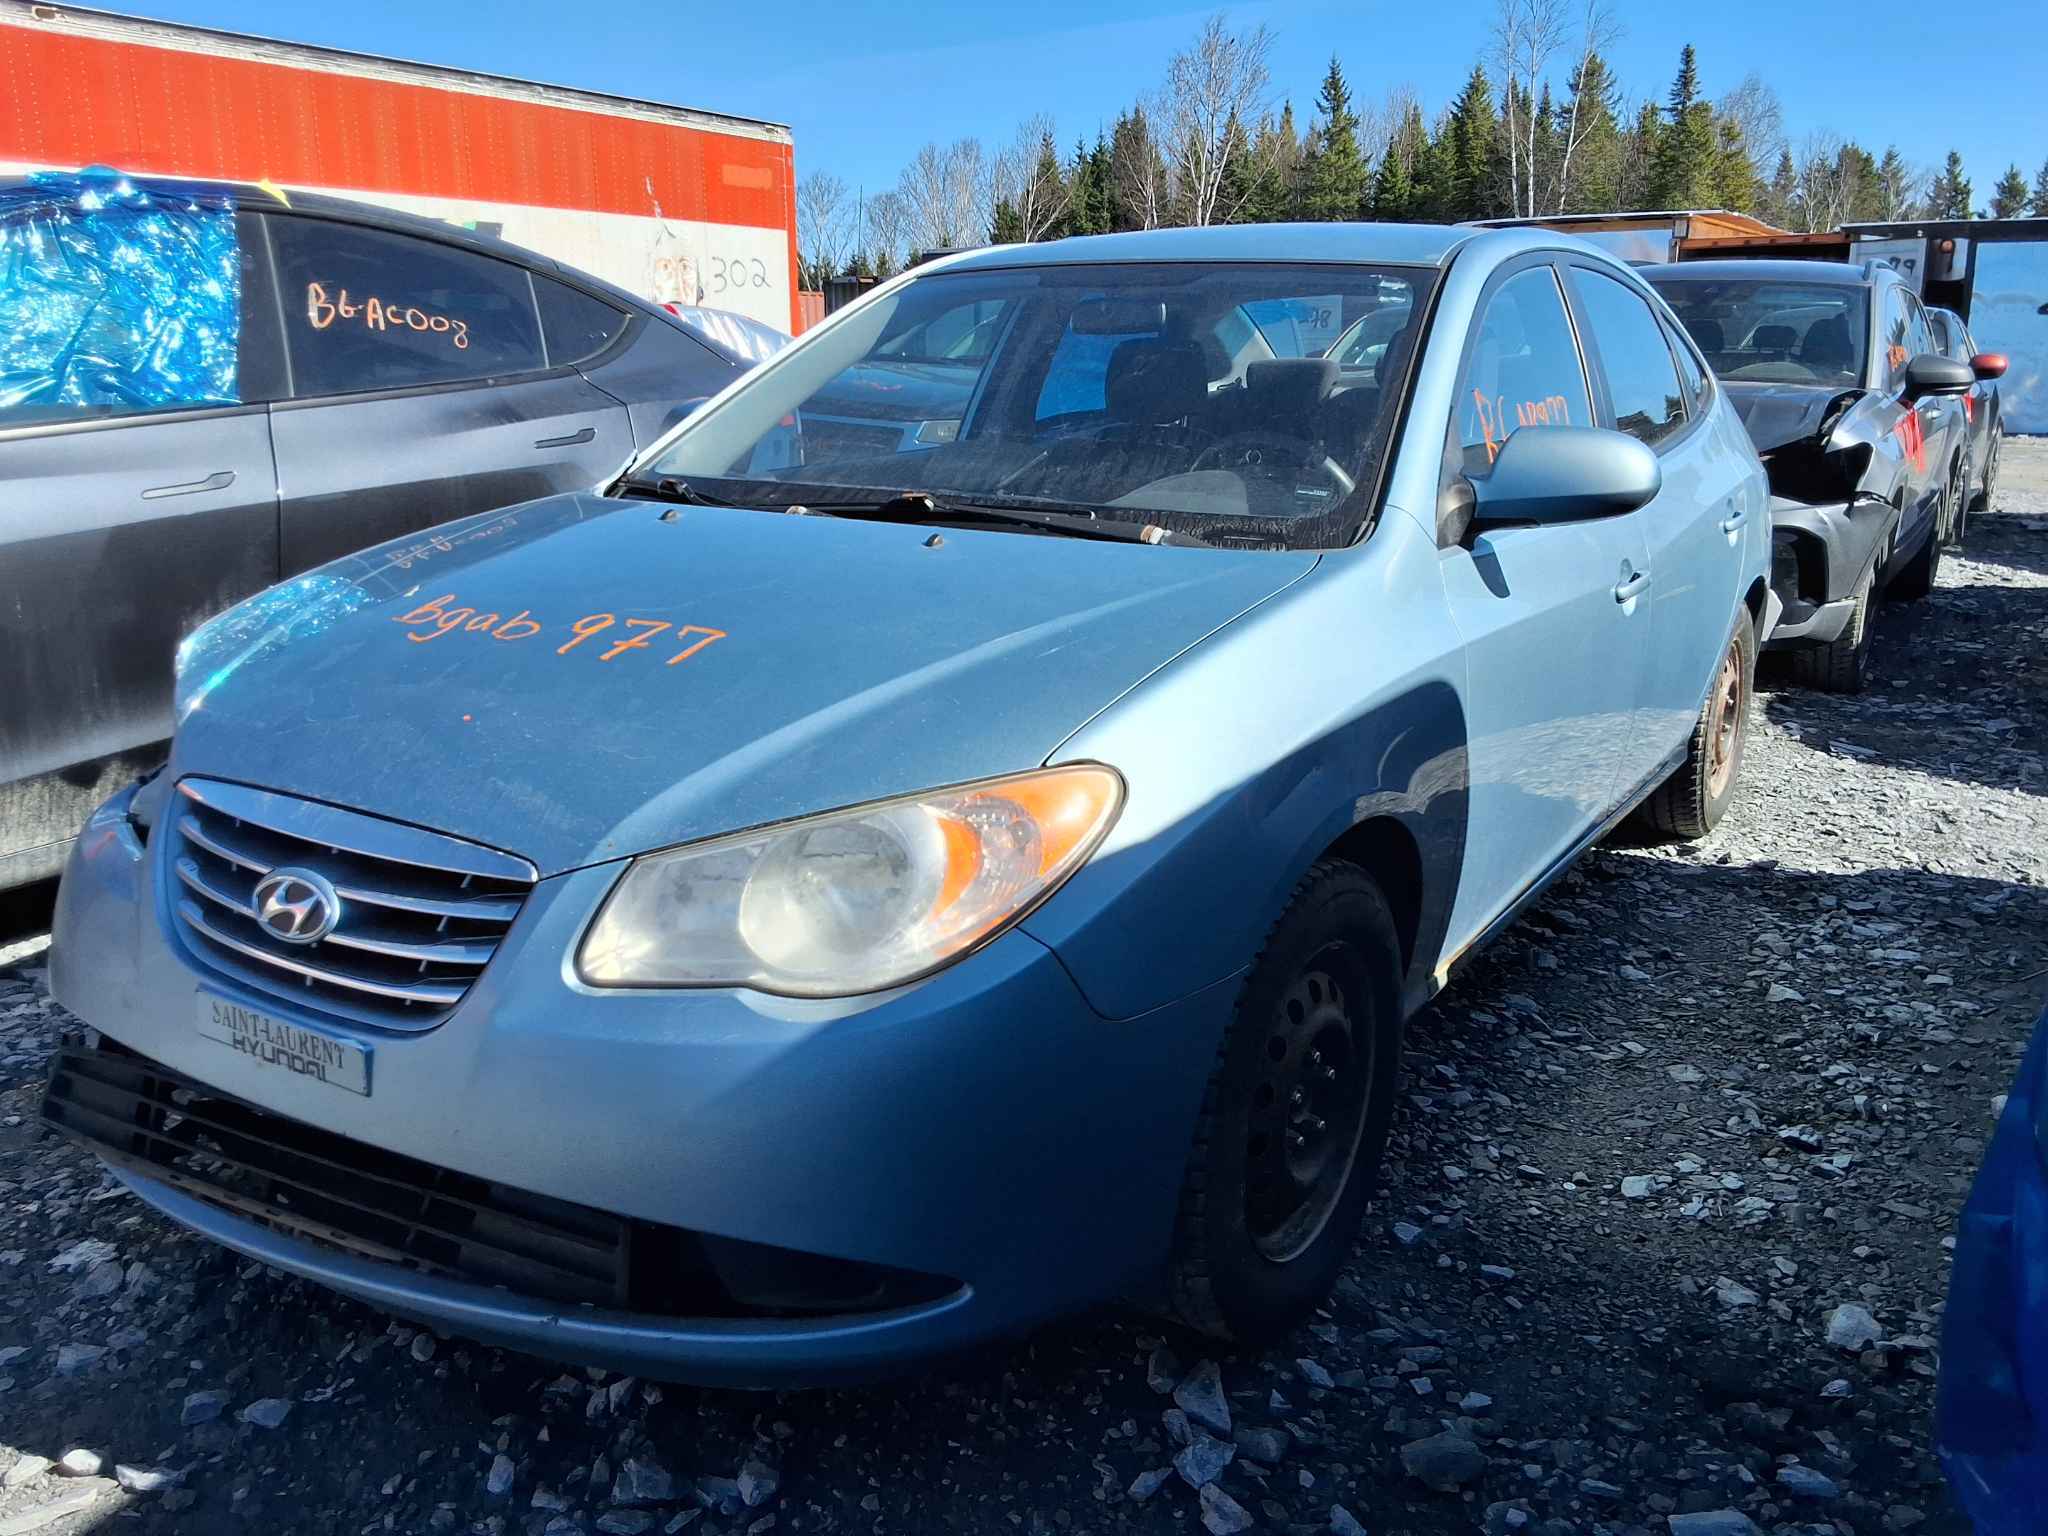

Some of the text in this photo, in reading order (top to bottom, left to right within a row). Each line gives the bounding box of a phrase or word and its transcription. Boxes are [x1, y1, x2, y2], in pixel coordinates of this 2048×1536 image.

[711, 256, 772, 293] 302
[556, 612, 728, 666] 977
[211, 1001, 345, 1070] SAINT-LAURENT
[232, 1031, 328, 1083] HYUNDAI
